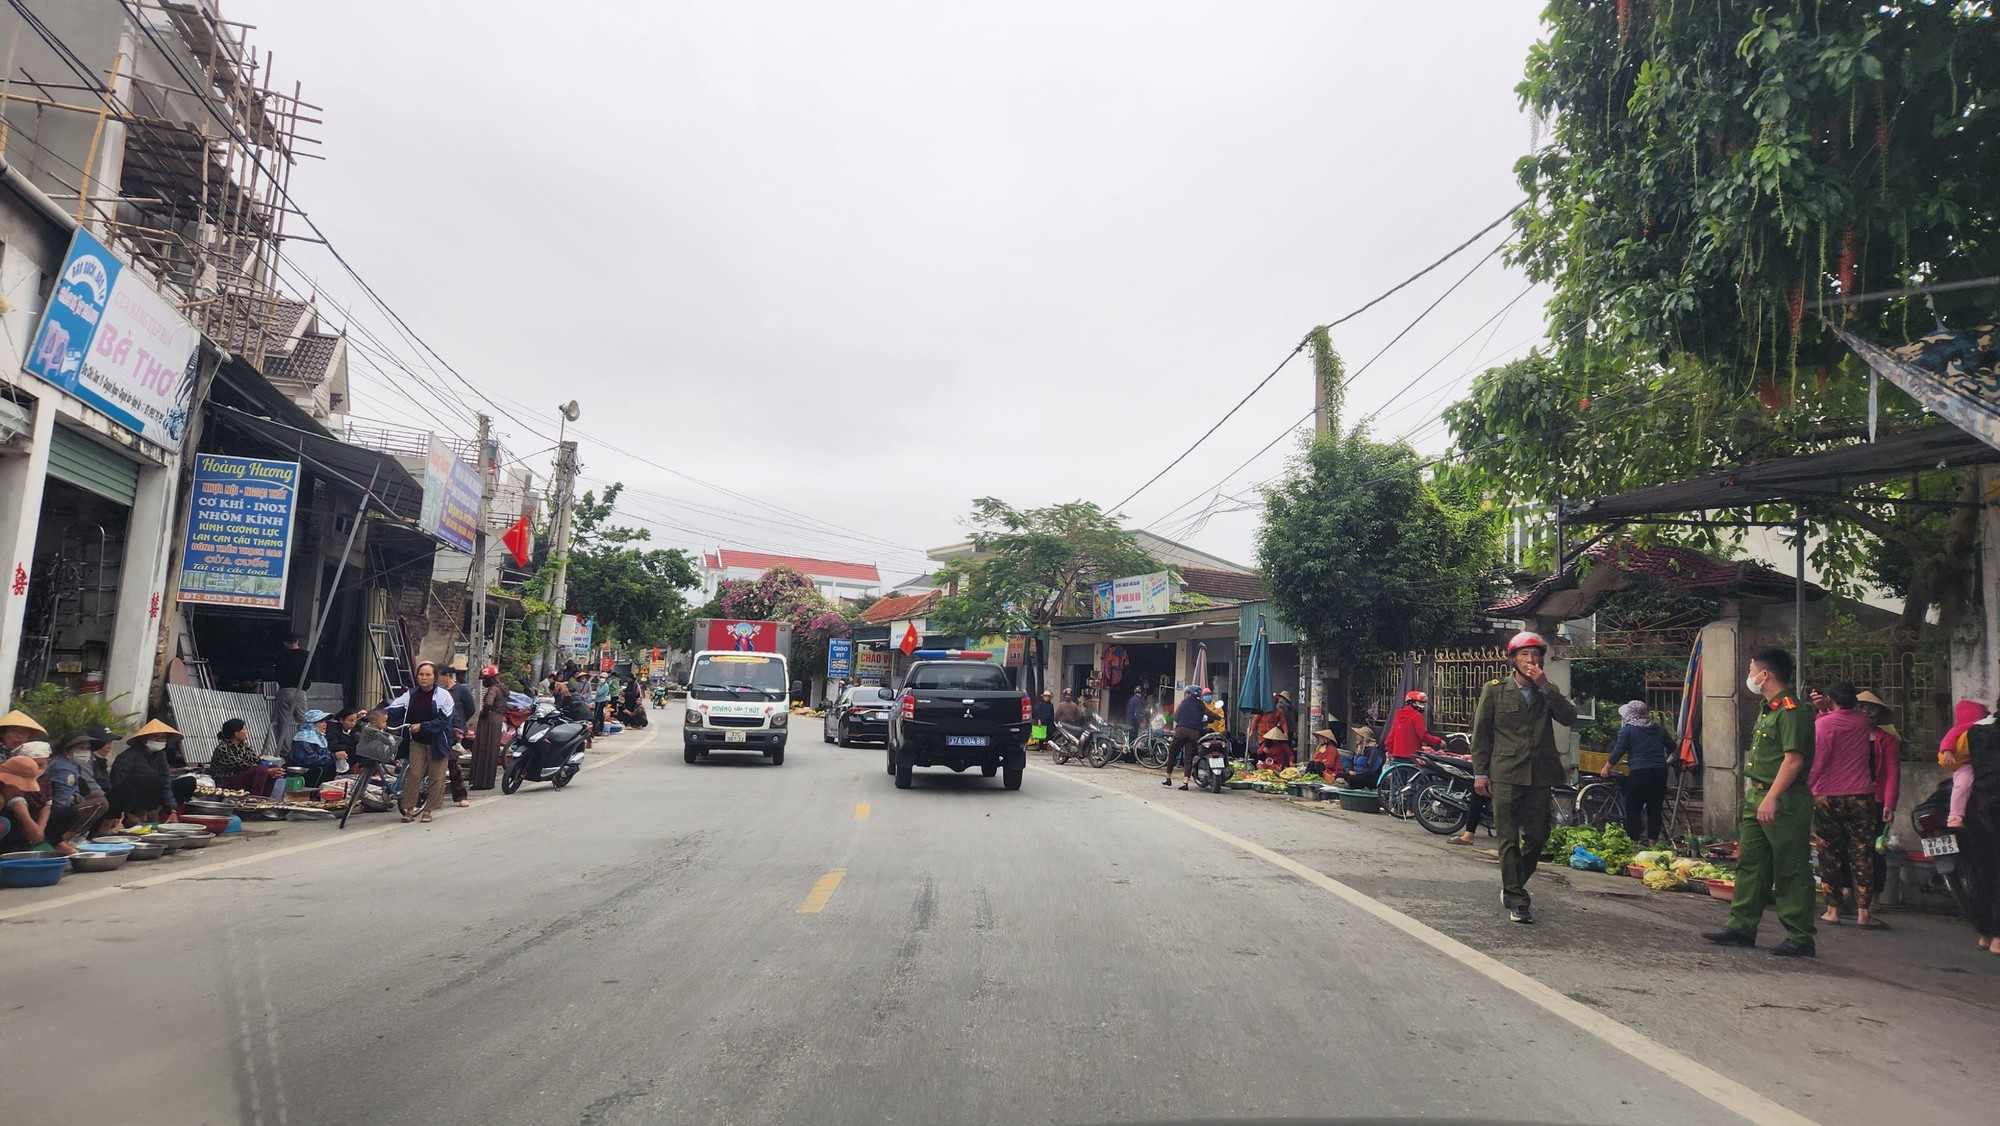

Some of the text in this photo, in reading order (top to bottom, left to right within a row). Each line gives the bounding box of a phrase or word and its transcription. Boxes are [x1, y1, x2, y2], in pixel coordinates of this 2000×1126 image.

[96, 322, 133, 367] BÀ
[132, 346, 179, 397] THƠ
[202, 458, 294, 483] Hoàng Hương
[202, 482, 224, 495] NHỰA
[224, 484, 239, 497] NỘI
[198, 497, 217, 506] CƠ
[219, 498, 244, 509] KHÍ
[253, 502, 288, 514] INOX
[198, 510, 284, 526] NHÔM KÍNH
[199, 522, 224, 531] KÍNH
[262, 528, 280, 538] LỰC
[192, 533, 210, 541] LAN
[213, 534, 231, 543] CAN
[253, 538, 283, 547] THANG
[204, 553, 270, 568] CỬA CUỐN
[226, 566, 246, 574] các
[204, 593, 230, 602] 0333
[233, 595, 252, 604] 871
[256, 597, 276, 606] 284
